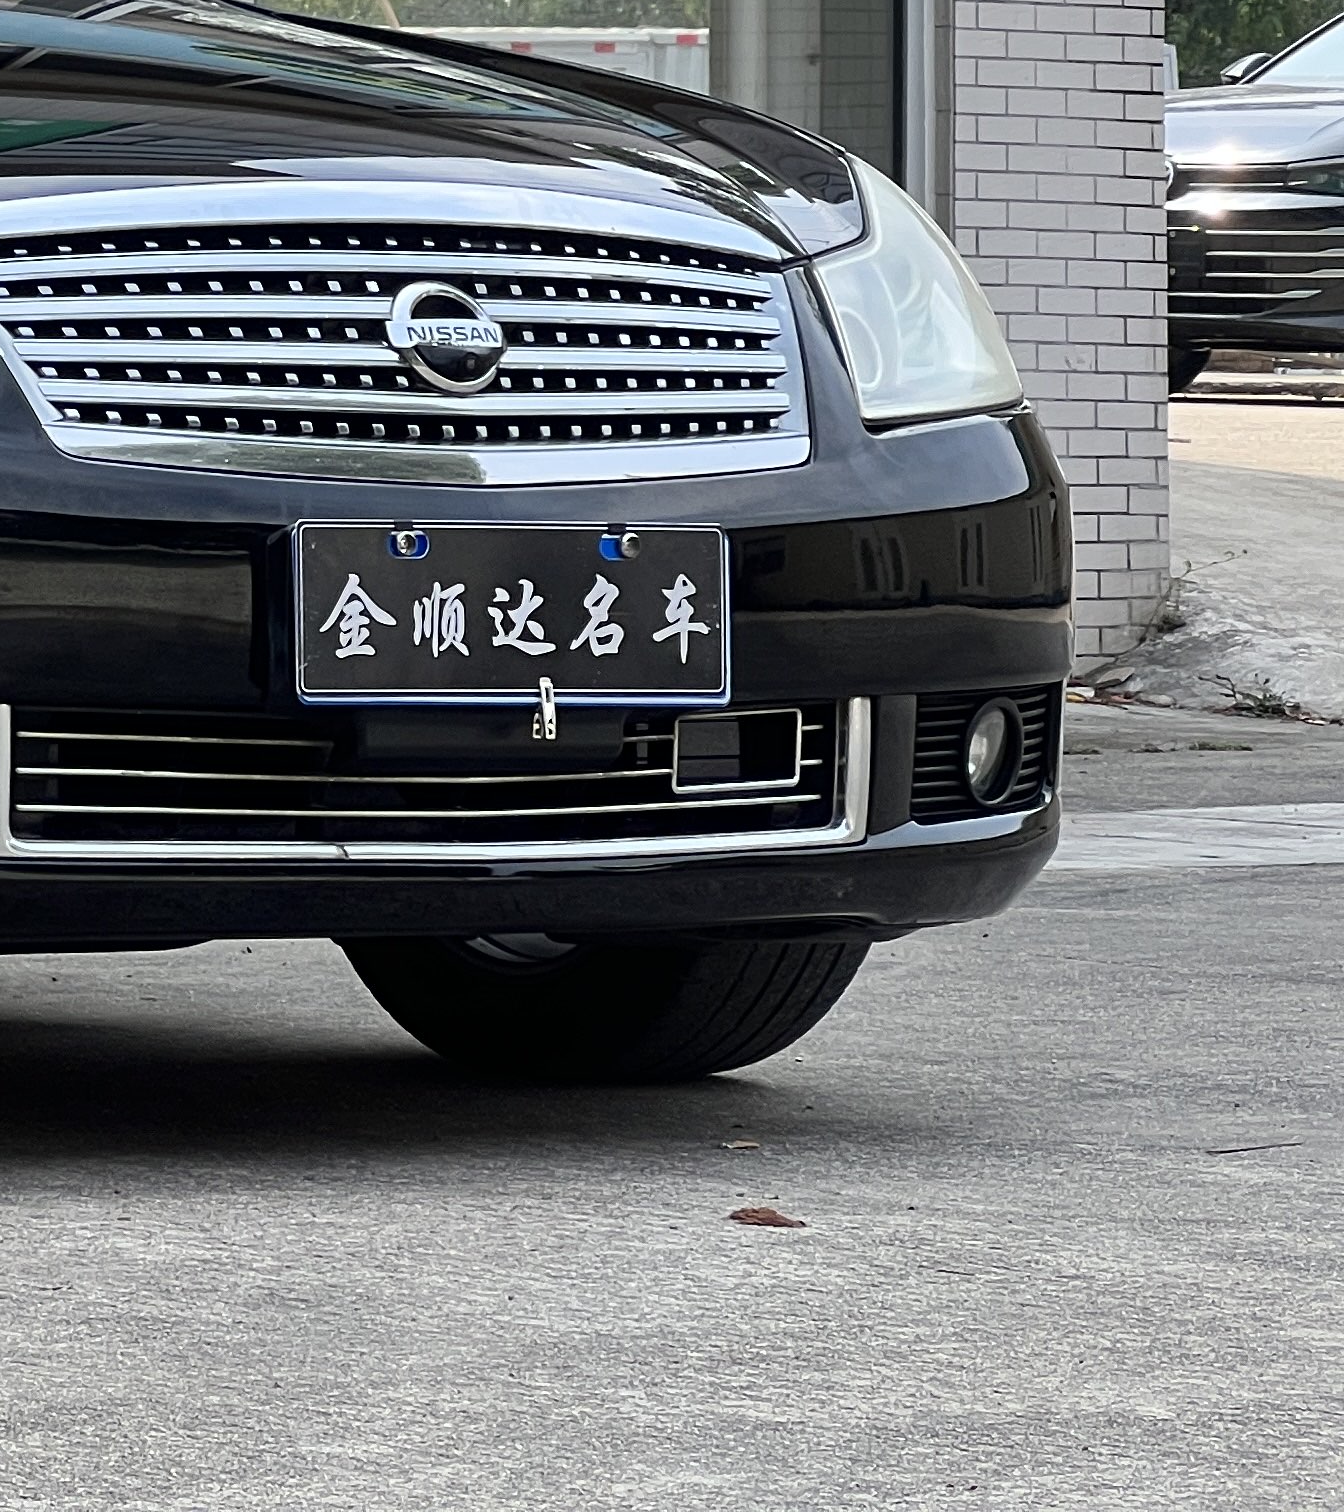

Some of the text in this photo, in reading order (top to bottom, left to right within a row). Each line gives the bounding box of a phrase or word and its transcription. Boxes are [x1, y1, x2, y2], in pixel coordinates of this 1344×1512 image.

[406, 325, 500, 344] NISSAN
[318, 572, 710, 664] 金顺达名车
